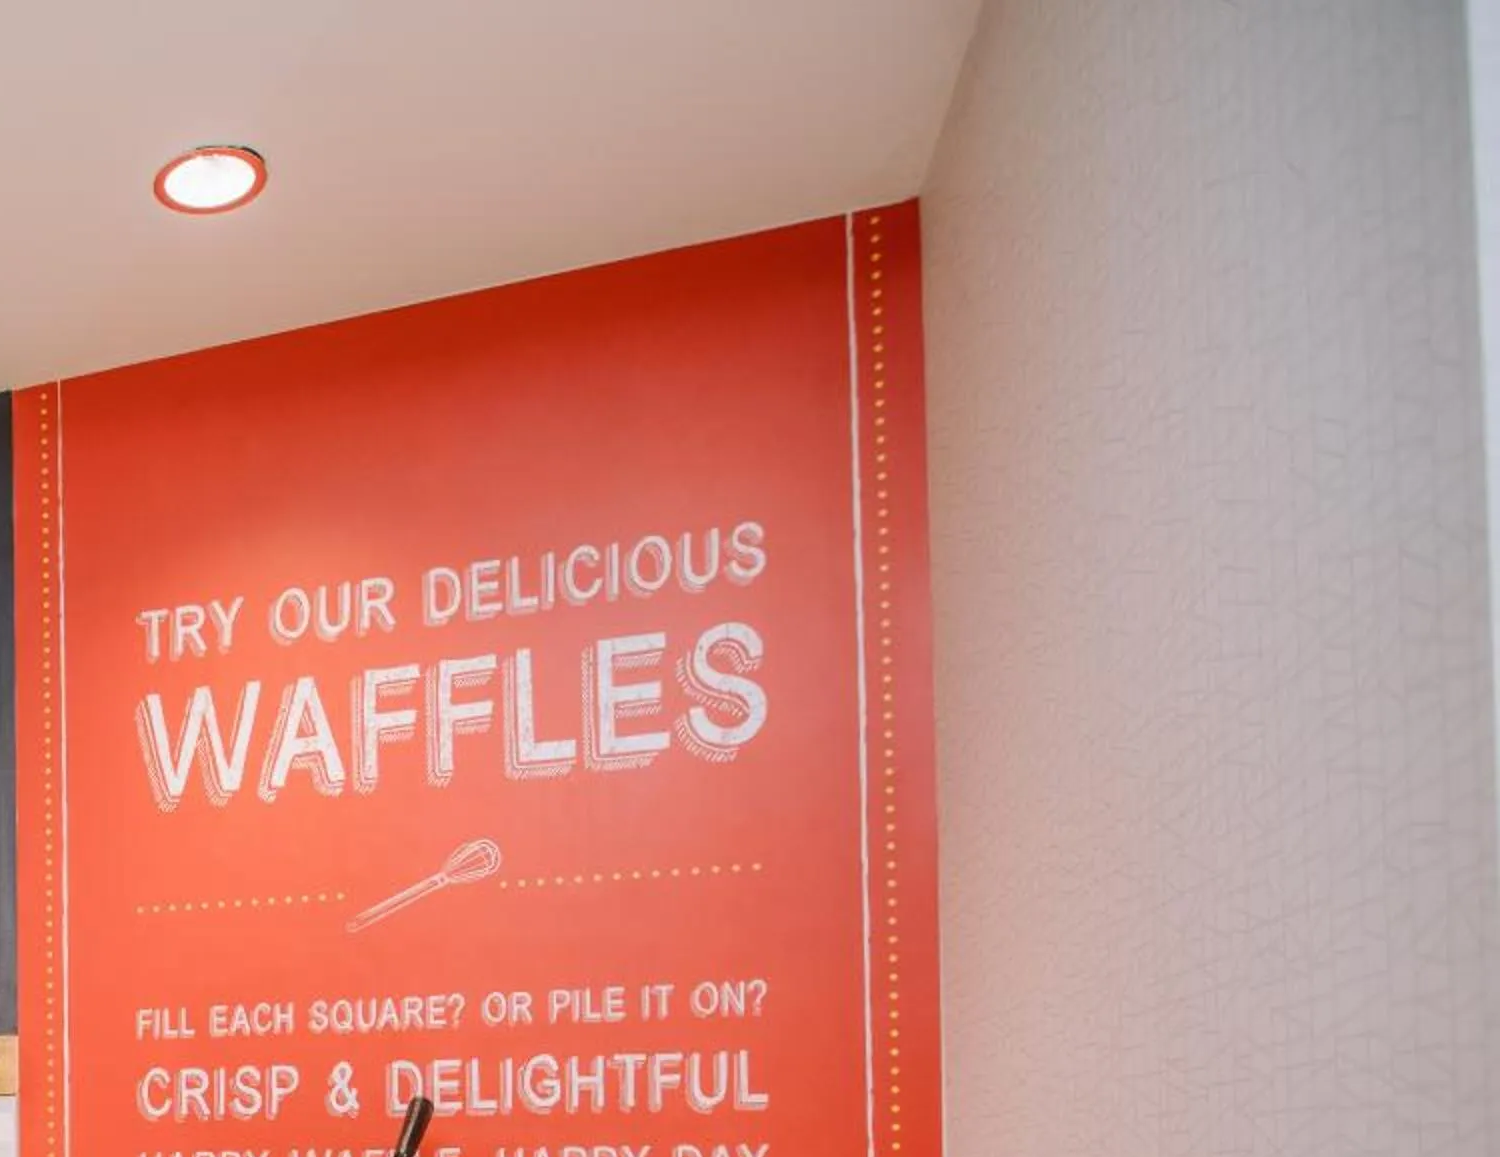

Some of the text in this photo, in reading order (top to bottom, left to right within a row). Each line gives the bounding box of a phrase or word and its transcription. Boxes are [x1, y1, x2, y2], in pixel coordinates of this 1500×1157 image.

[136, 522, 767, 664] TRY OUR DELICIOUS
[135, 622, 768, 812] WAFFLES
[136, 979, 768, 1040] FILL EACH SQUARE? OR PILE IT ON?
[136, 1050, 769, 1121] CRISP & DELIGHTFUL
